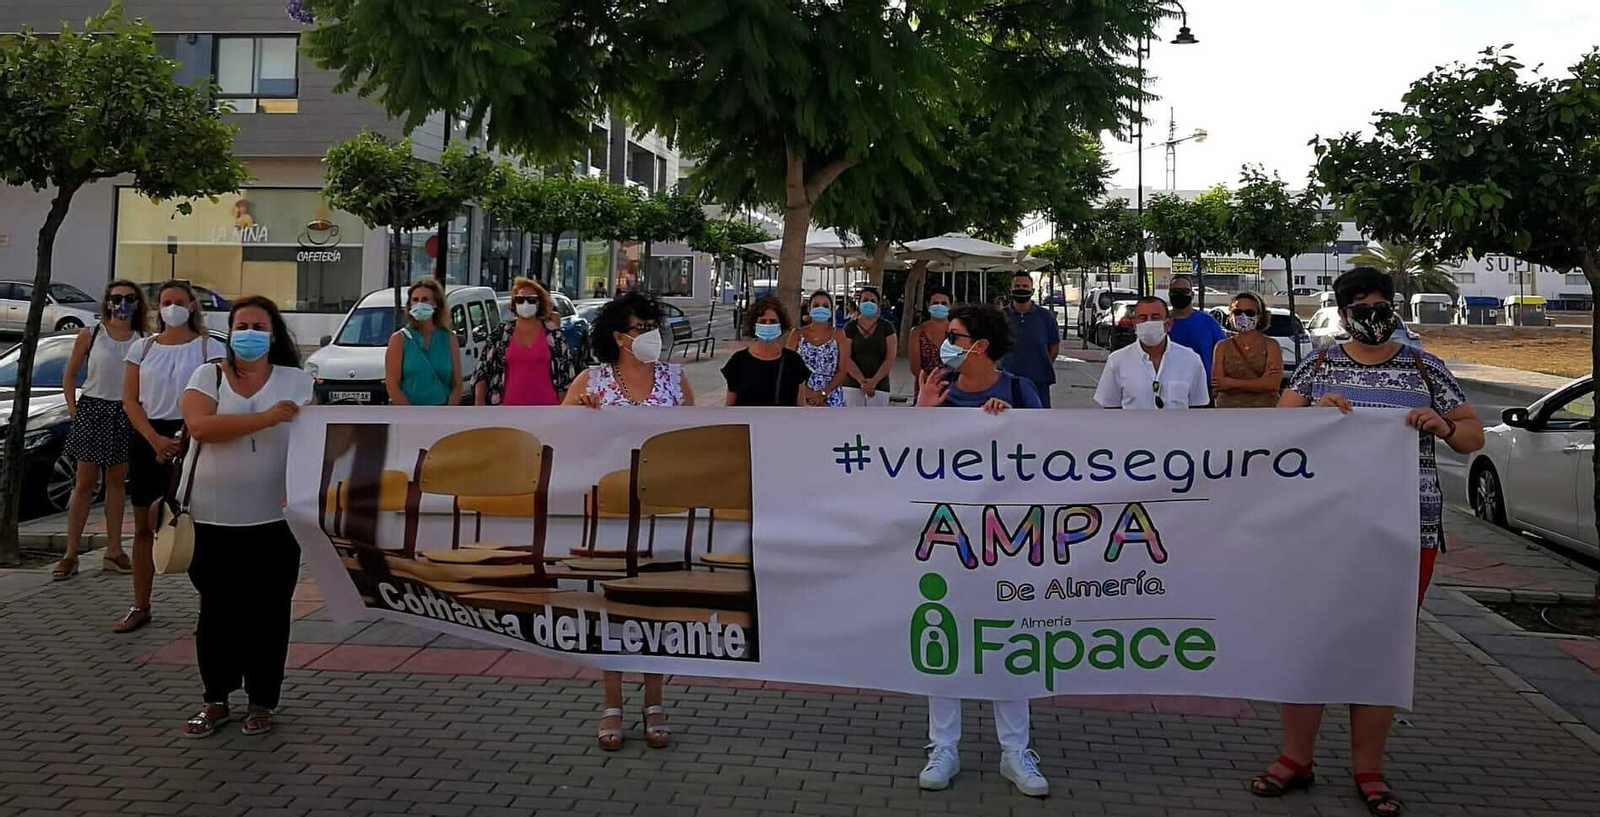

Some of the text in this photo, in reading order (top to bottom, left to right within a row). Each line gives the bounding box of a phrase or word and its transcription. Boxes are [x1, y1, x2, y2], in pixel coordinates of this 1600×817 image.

[234, 224, 269, 242] NIÑA
[297, 250, 341, 262] CAFETERÍA
[833, 433, 1315, 493] #vueltasegura
[915, 502, 1168, 569] AMPA
[996, 570, 1166, 602] De Almería
[378, 582, 746, 658] Comarca del Levante
[1020, 615, 1072, 628] Almería
[973, 618, 1217, 692] Fapace
